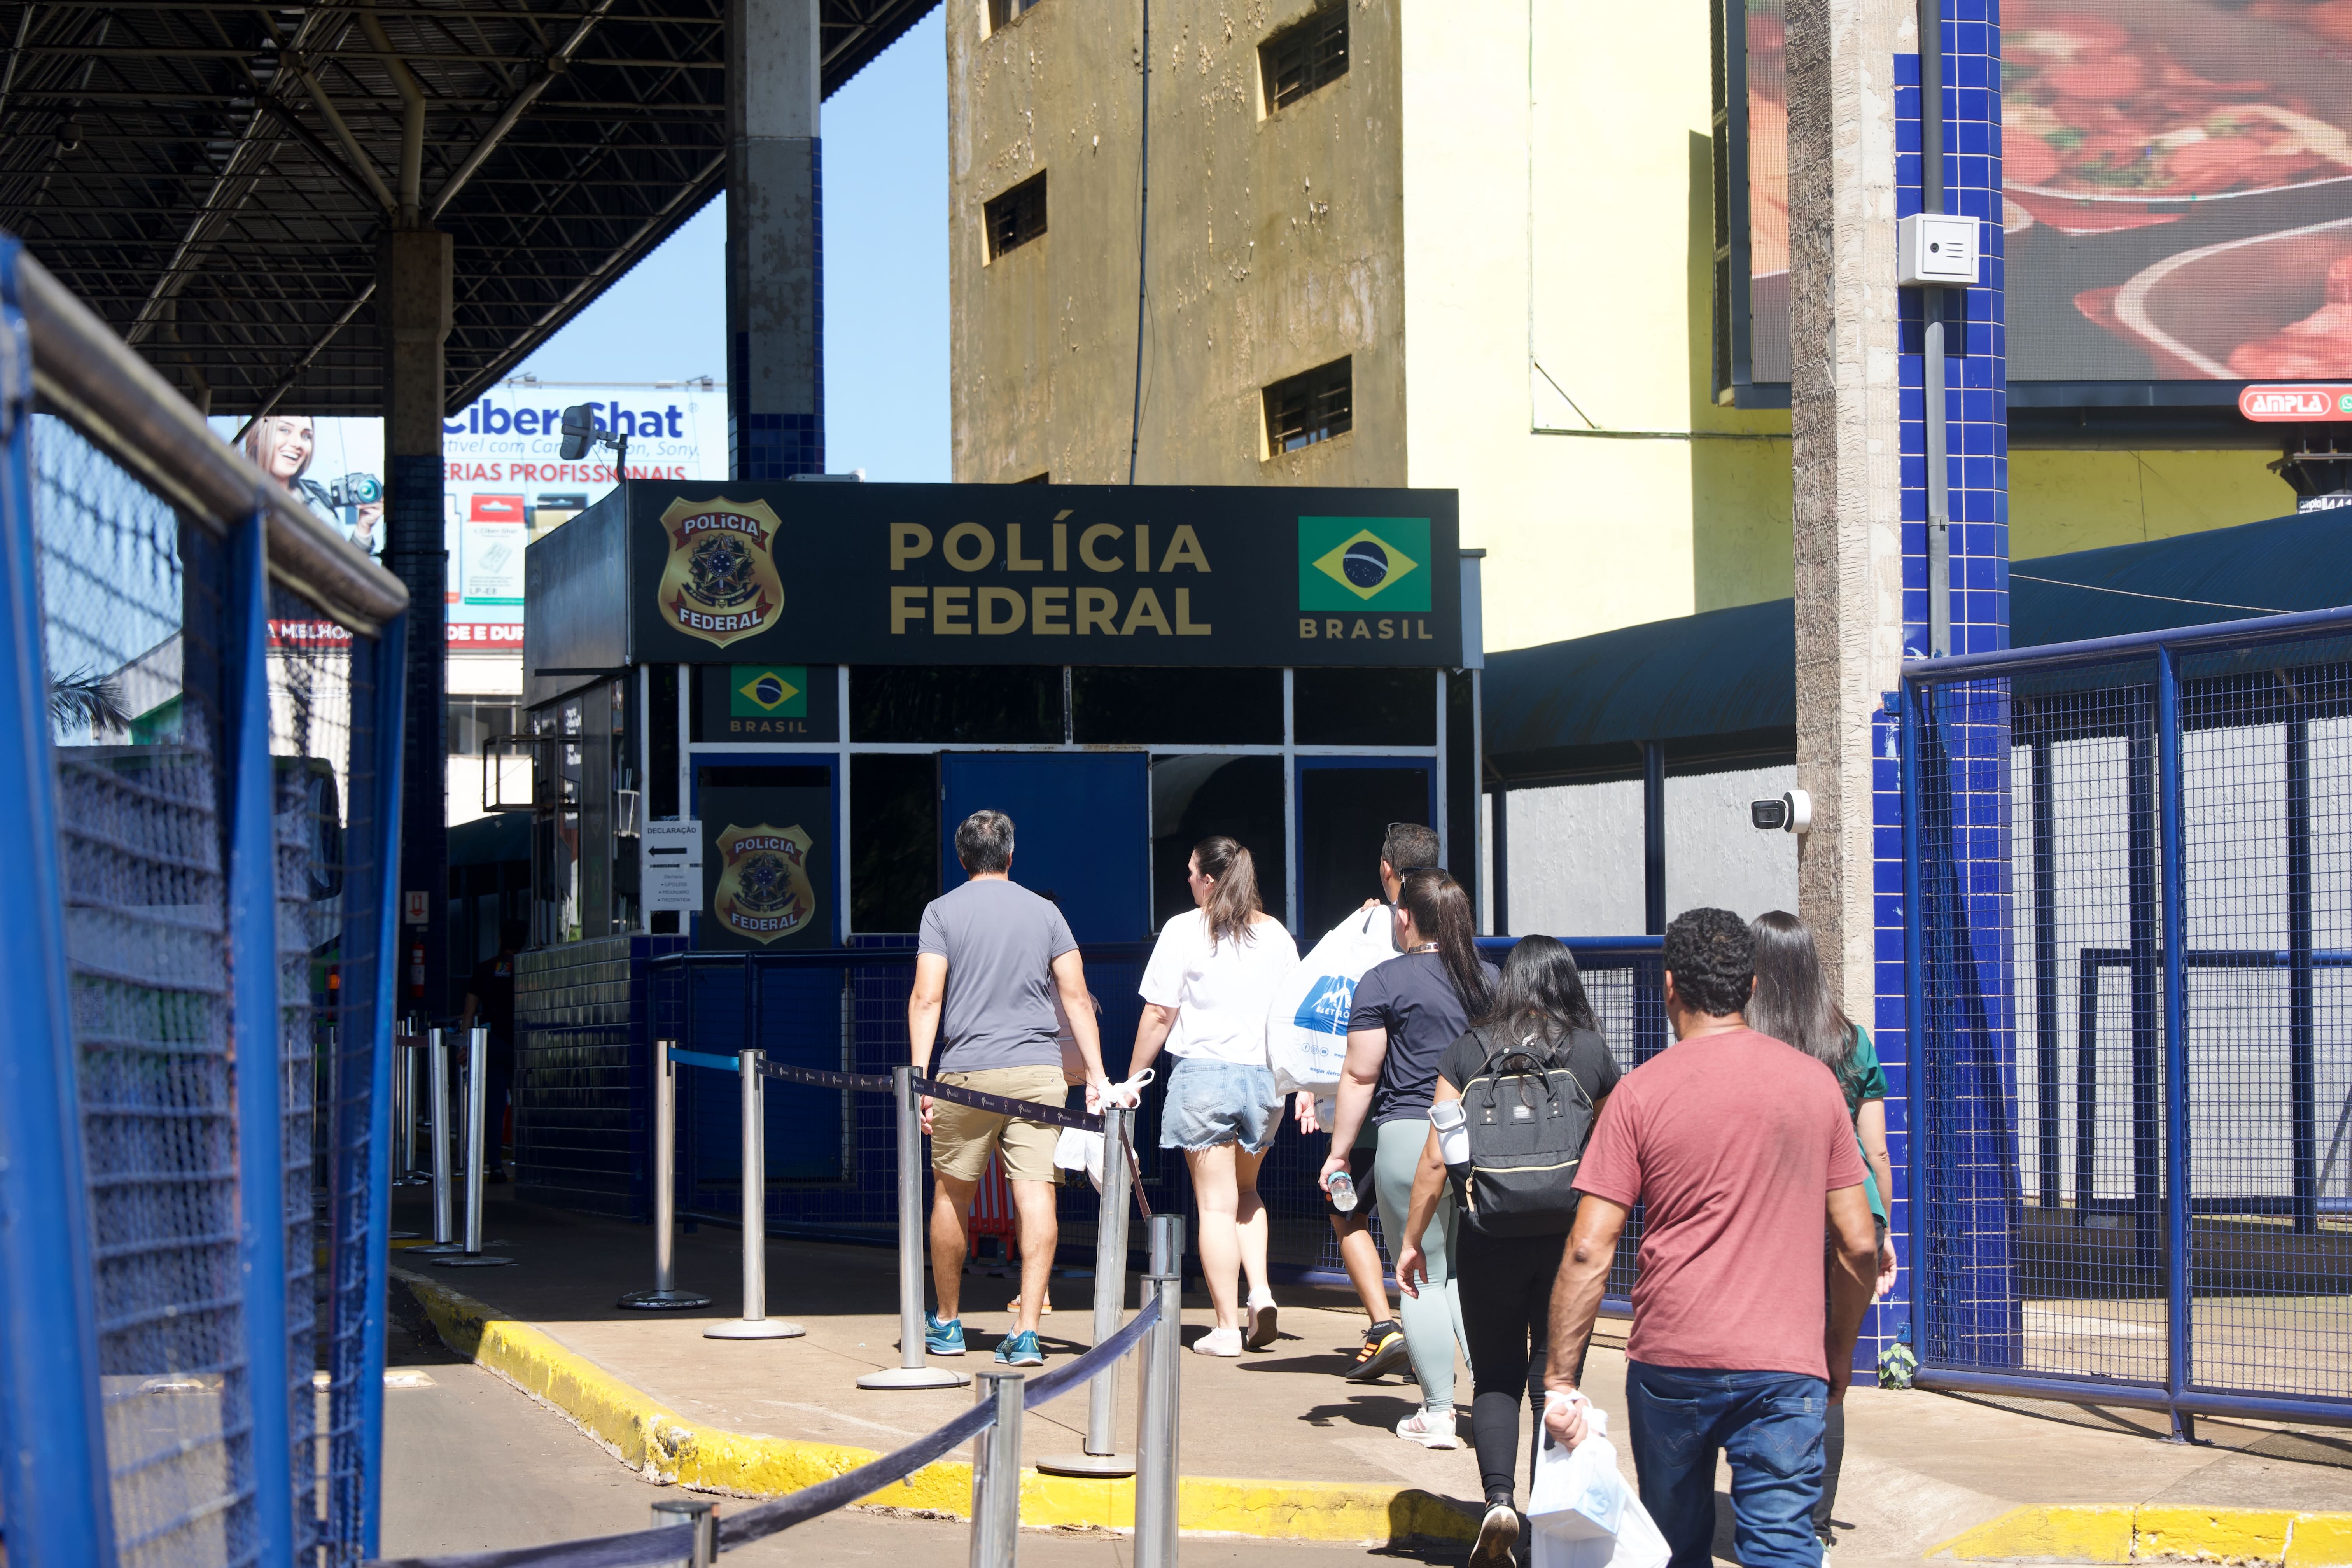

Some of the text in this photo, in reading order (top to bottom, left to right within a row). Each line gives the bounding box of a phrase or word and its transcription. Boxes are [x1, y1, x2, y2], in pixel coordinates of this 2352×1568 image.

[2252, 395, 2323, 412] AMPLA
[490, 441, 525, 453] com
[890, 510, 1212, 573] POLÍCIA
[679, 607, 763, 631] FEDERAL
[891, 586, 1211, 635] FEDERAL
[474, 626, 486, 640] E
[1299, 619, 1433, 639] BRASIL
[730, 721, 807, 733] BRASIL
[648, 826, 696, 835] DECLARAÇÃO
[732, 913, 798, 931] FEDERAL
